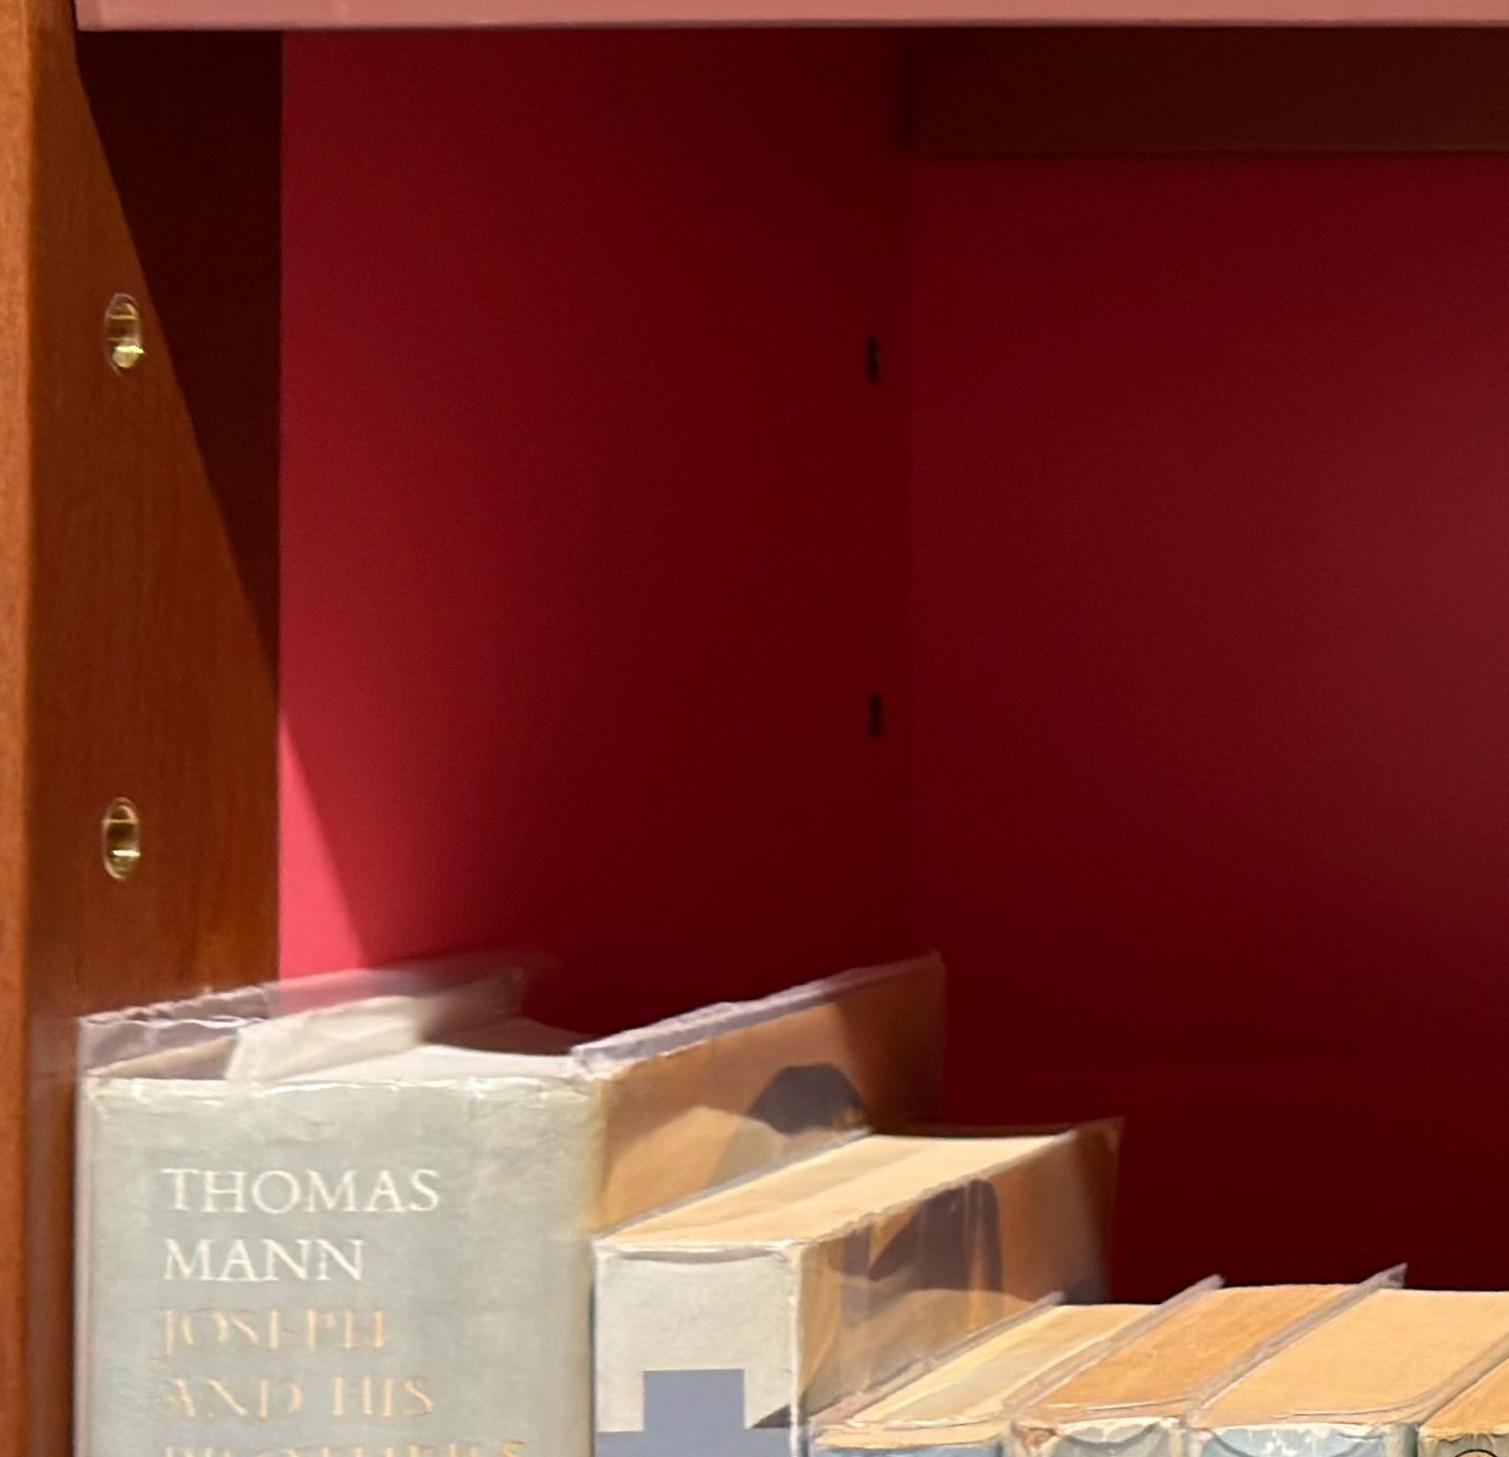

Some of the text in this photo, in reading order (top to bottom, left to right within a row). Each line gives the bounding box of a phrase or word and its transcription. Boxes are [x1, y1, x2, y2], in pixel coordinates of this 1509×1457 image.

[163, 1169, 439, 1214] THOMAS
[163, 1239, 365, 1282] MANN
[163, 1308, 387, 1356] JOSEPH
[167, 1376, 434, 1421] AND HIS
